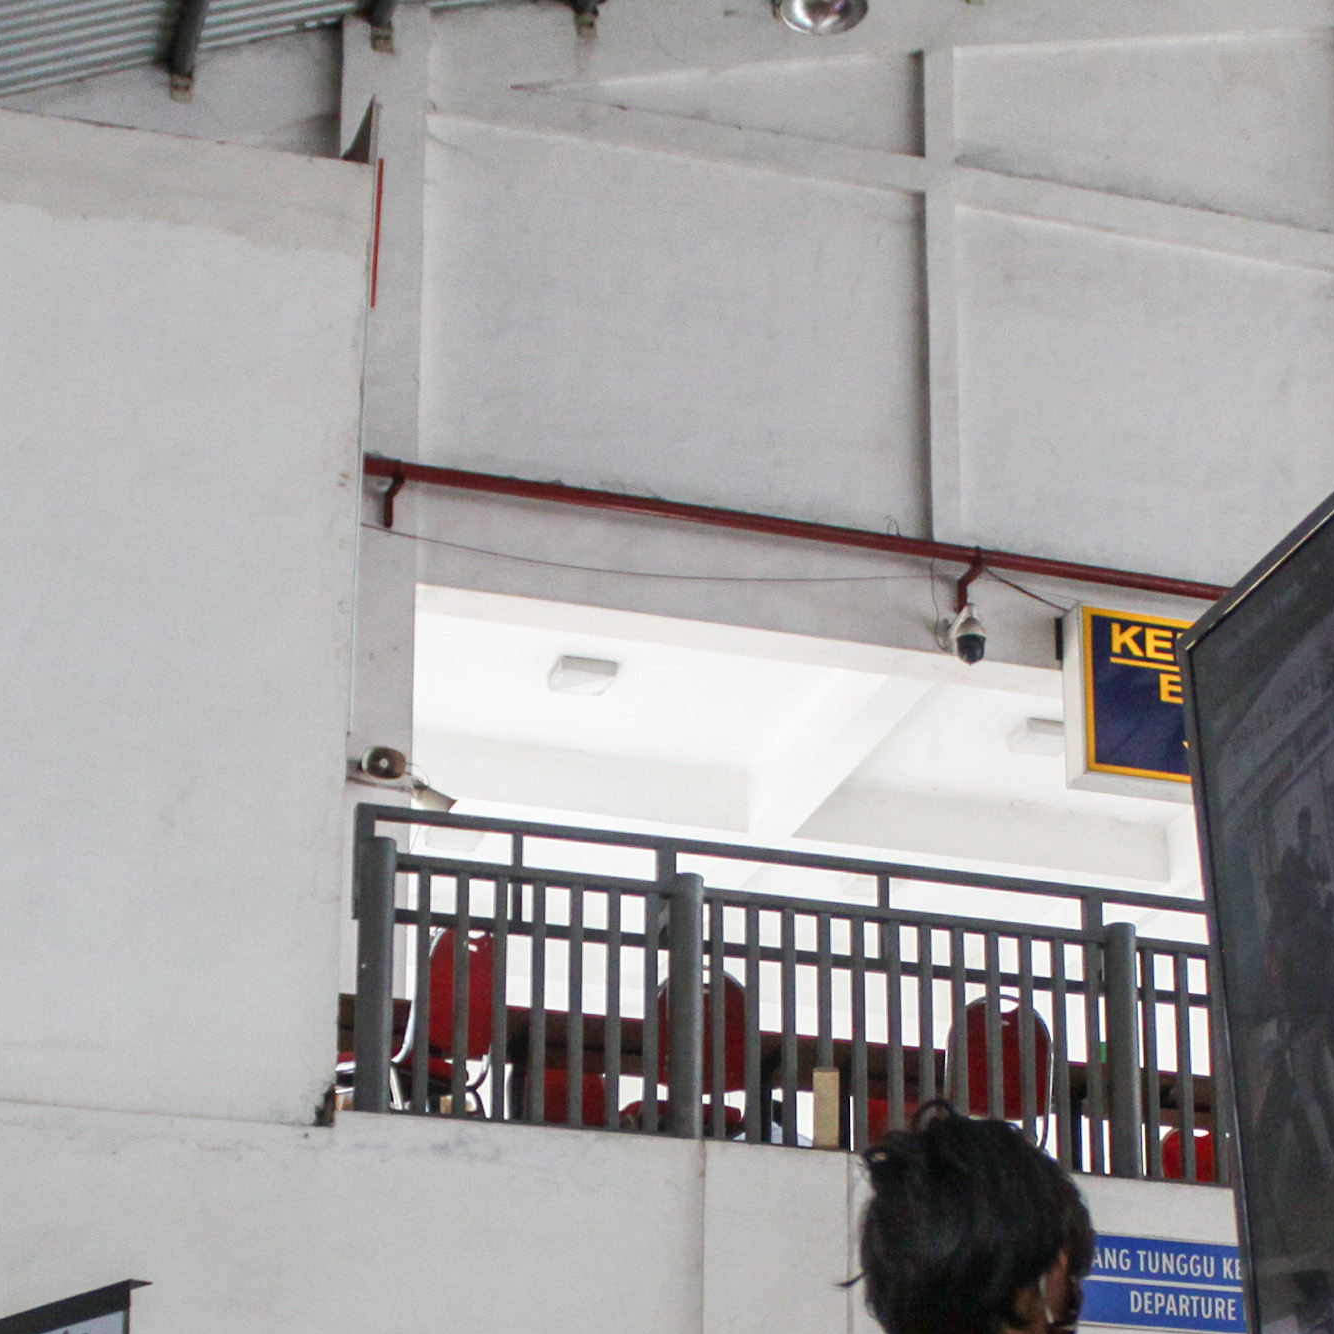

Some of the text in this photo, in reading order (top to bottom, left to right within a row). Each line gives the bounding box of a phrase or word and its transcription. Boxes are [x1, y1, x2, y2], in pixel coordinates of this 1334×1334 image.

[1111, 623, 1183, 661] KE
[1137, 1250, 1216, 1279] TUNGGU
[1130, 1290, 1238, 1320] DEPARTURE
